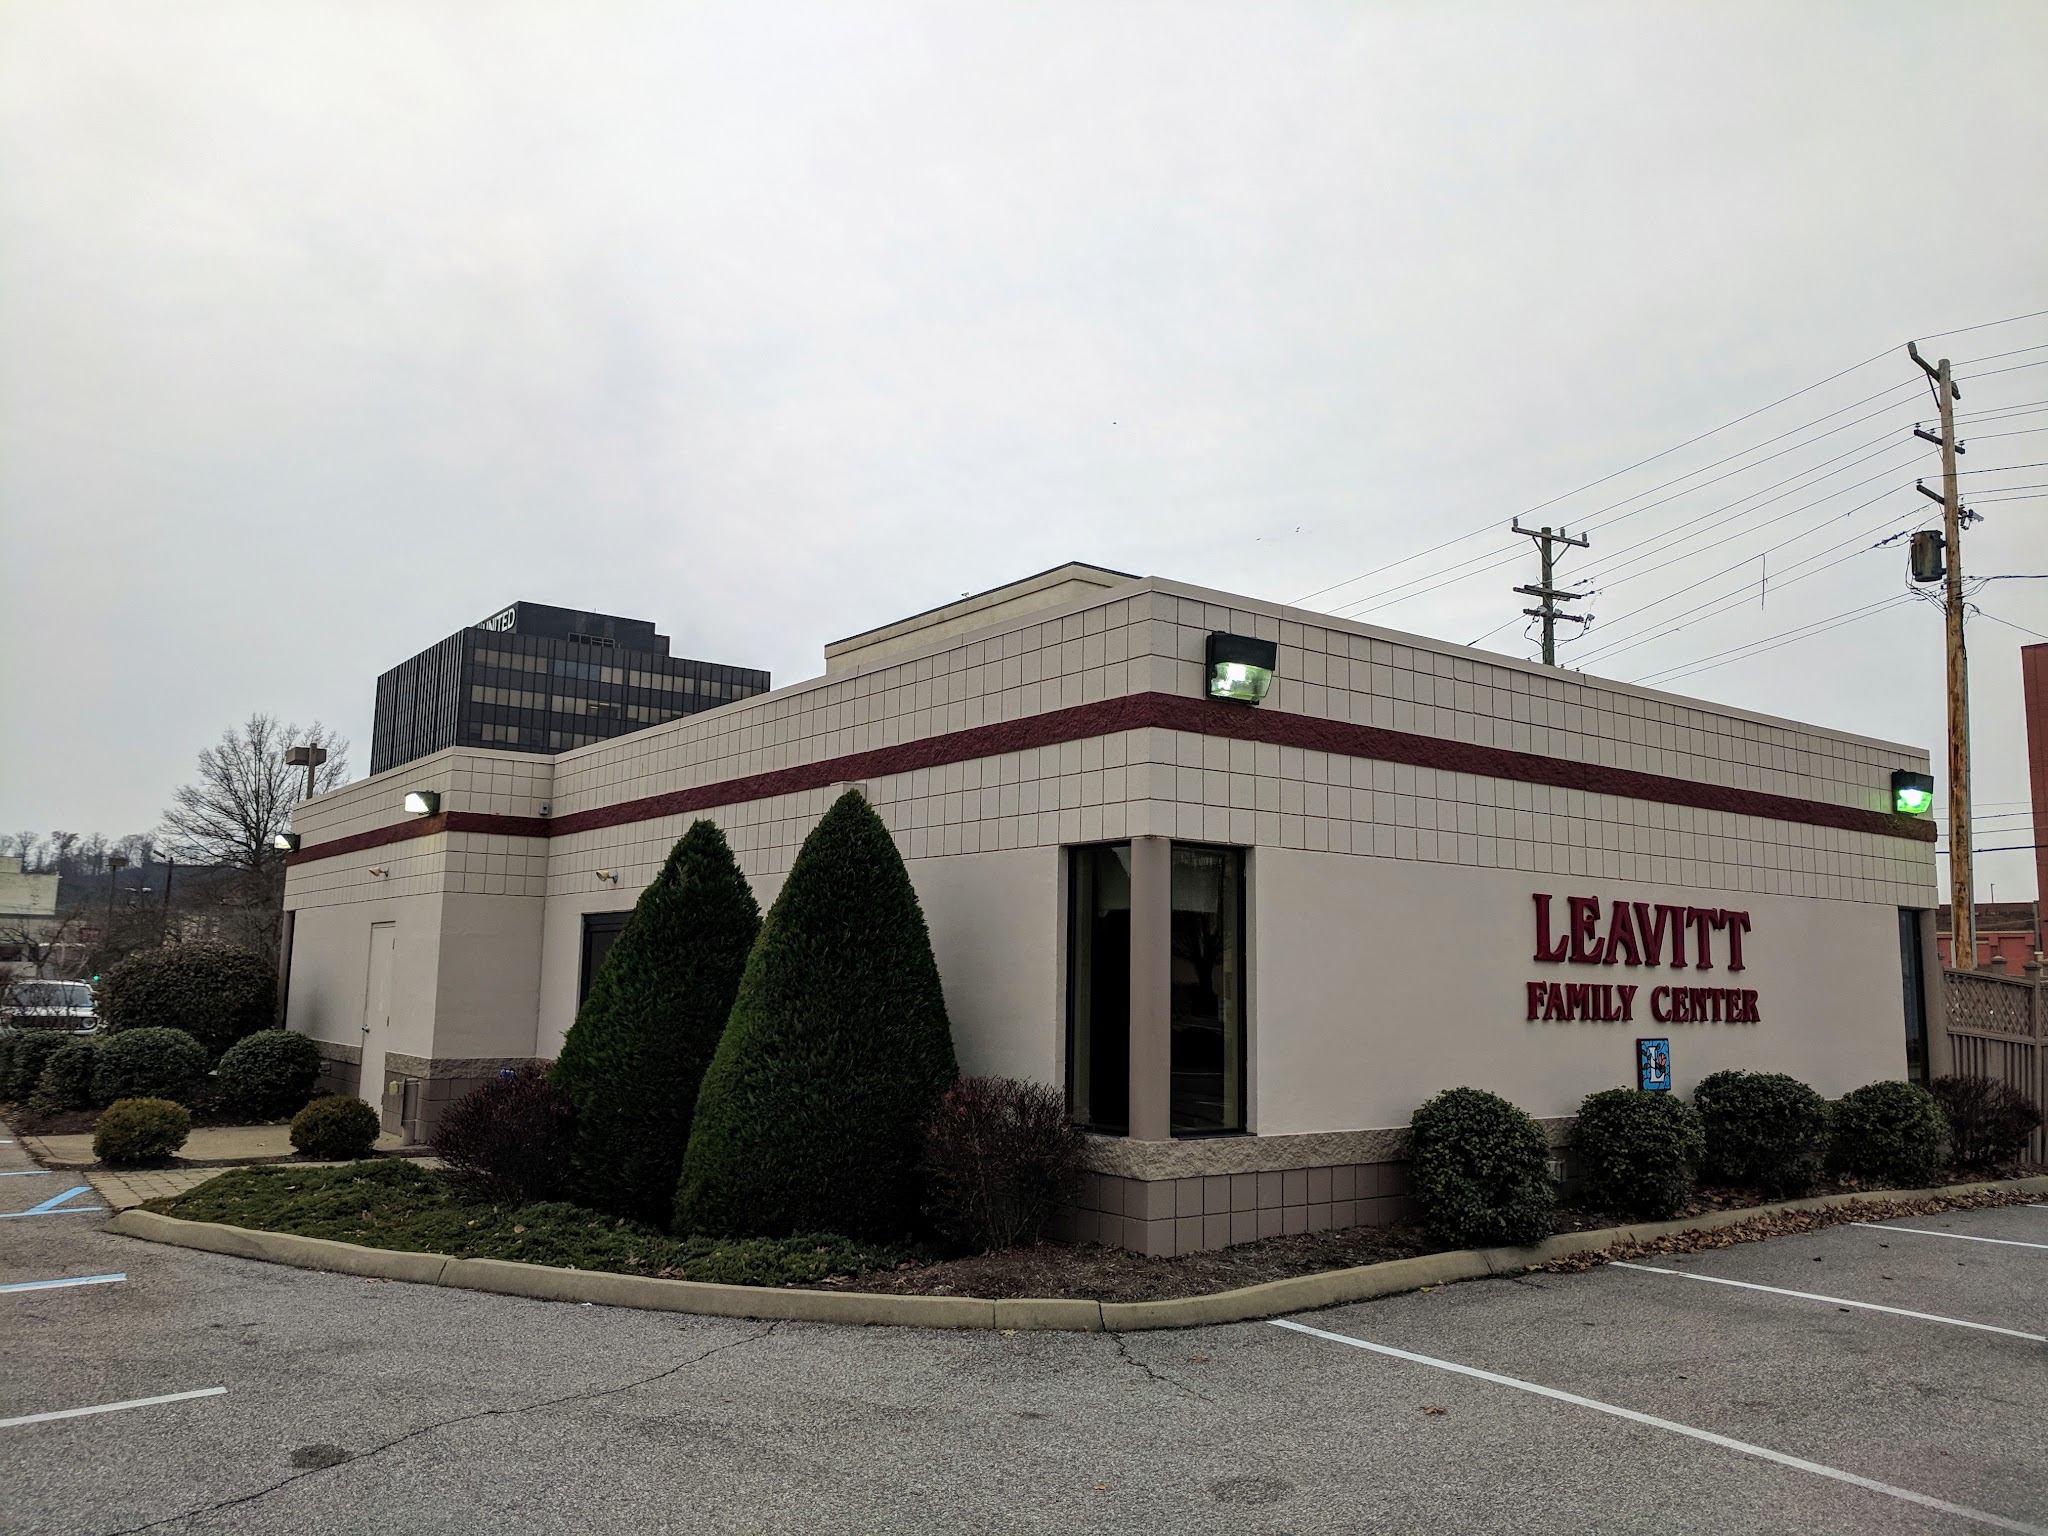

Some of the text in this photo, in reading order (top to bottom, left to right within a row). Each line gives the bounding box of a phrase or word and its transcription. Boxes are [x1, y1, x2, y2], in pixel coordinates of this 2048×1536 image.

[1532, 893, 1751, 970] LEAVITT
[1527, 981, 1761, 1022] FAMILY CENTER
[1647, 1046, 1665, 1082] L
